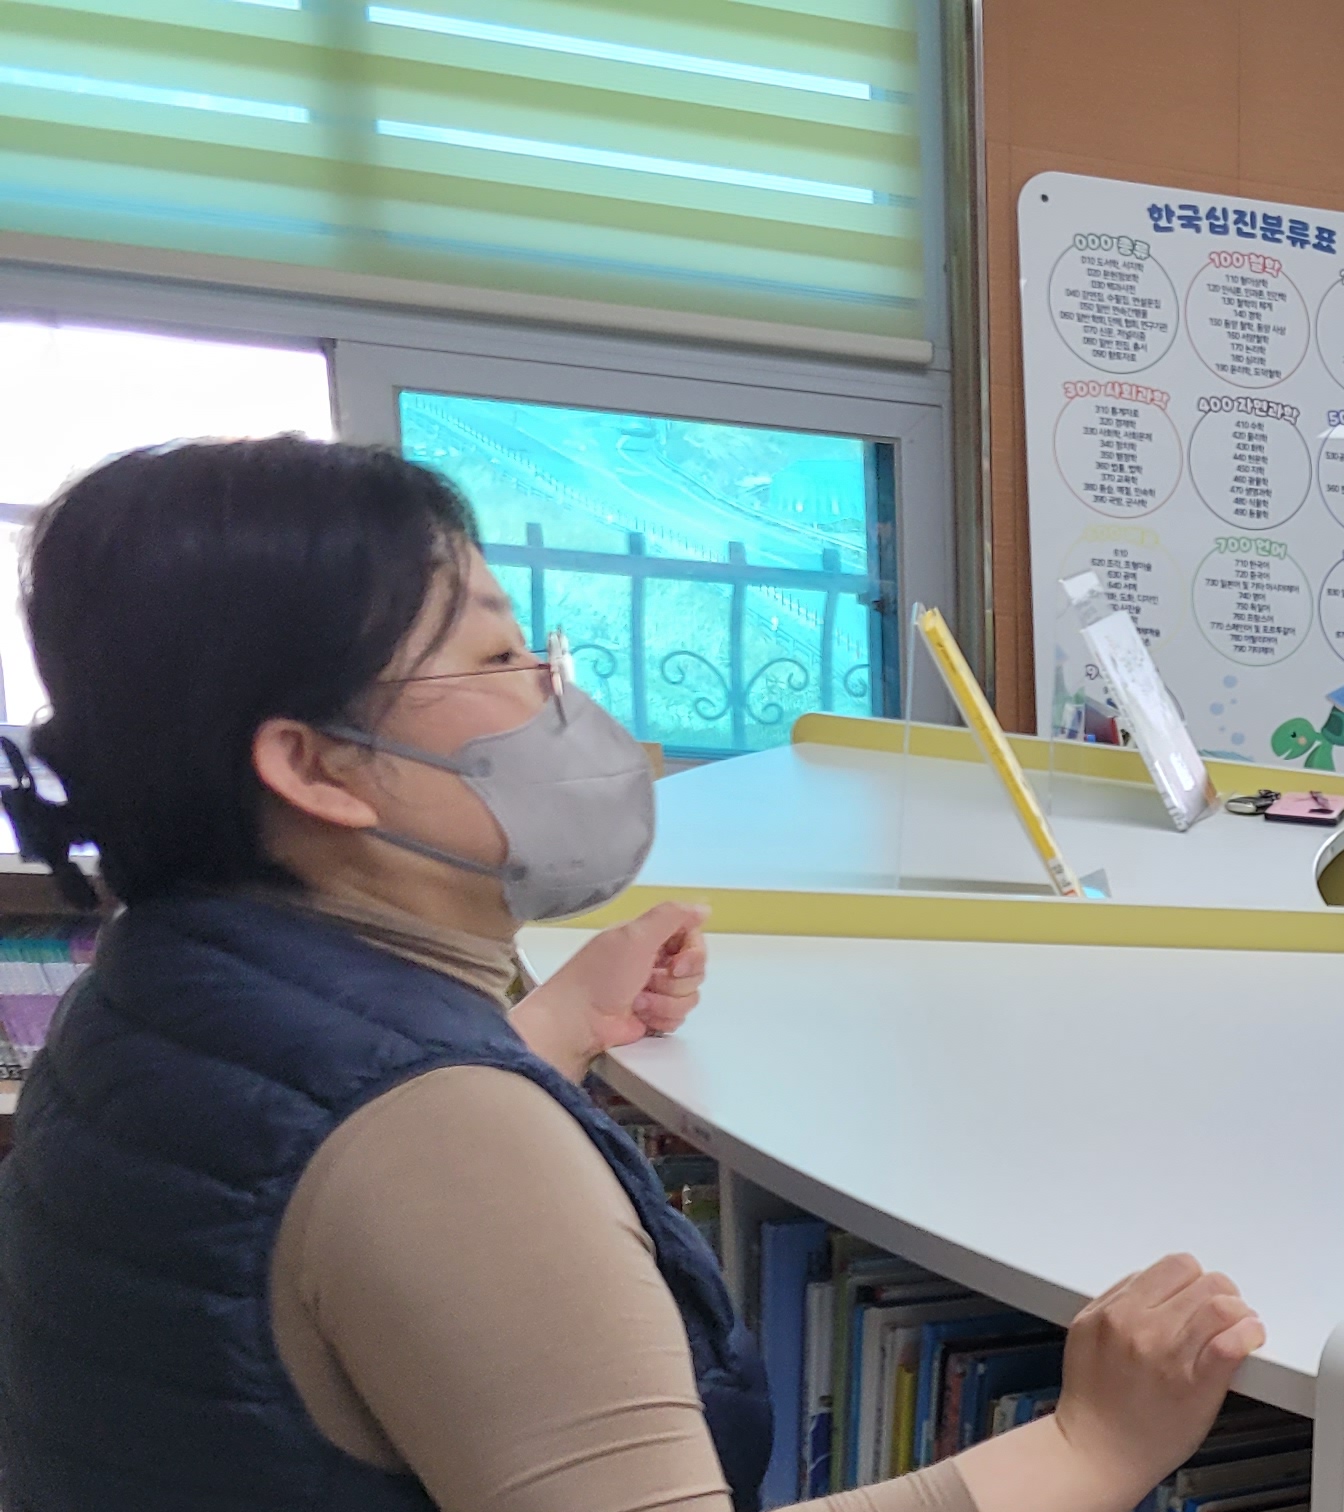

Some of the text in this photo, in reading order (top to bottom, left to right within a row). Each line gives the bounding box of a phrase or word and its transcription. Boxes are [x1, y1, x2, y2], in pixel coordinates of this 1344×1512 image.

[1073, 233, 1113, 251] 000
[1147, 203, 1337, 254] 한국십진분류표
[1209, 251, 1282, 278] 100 철학
[1062, 380, 1171, 411] 300 사회과학
[1198, 396, 1300, 426] 400 자연과학
[1214, 536, 1288, 560] 700 언어
